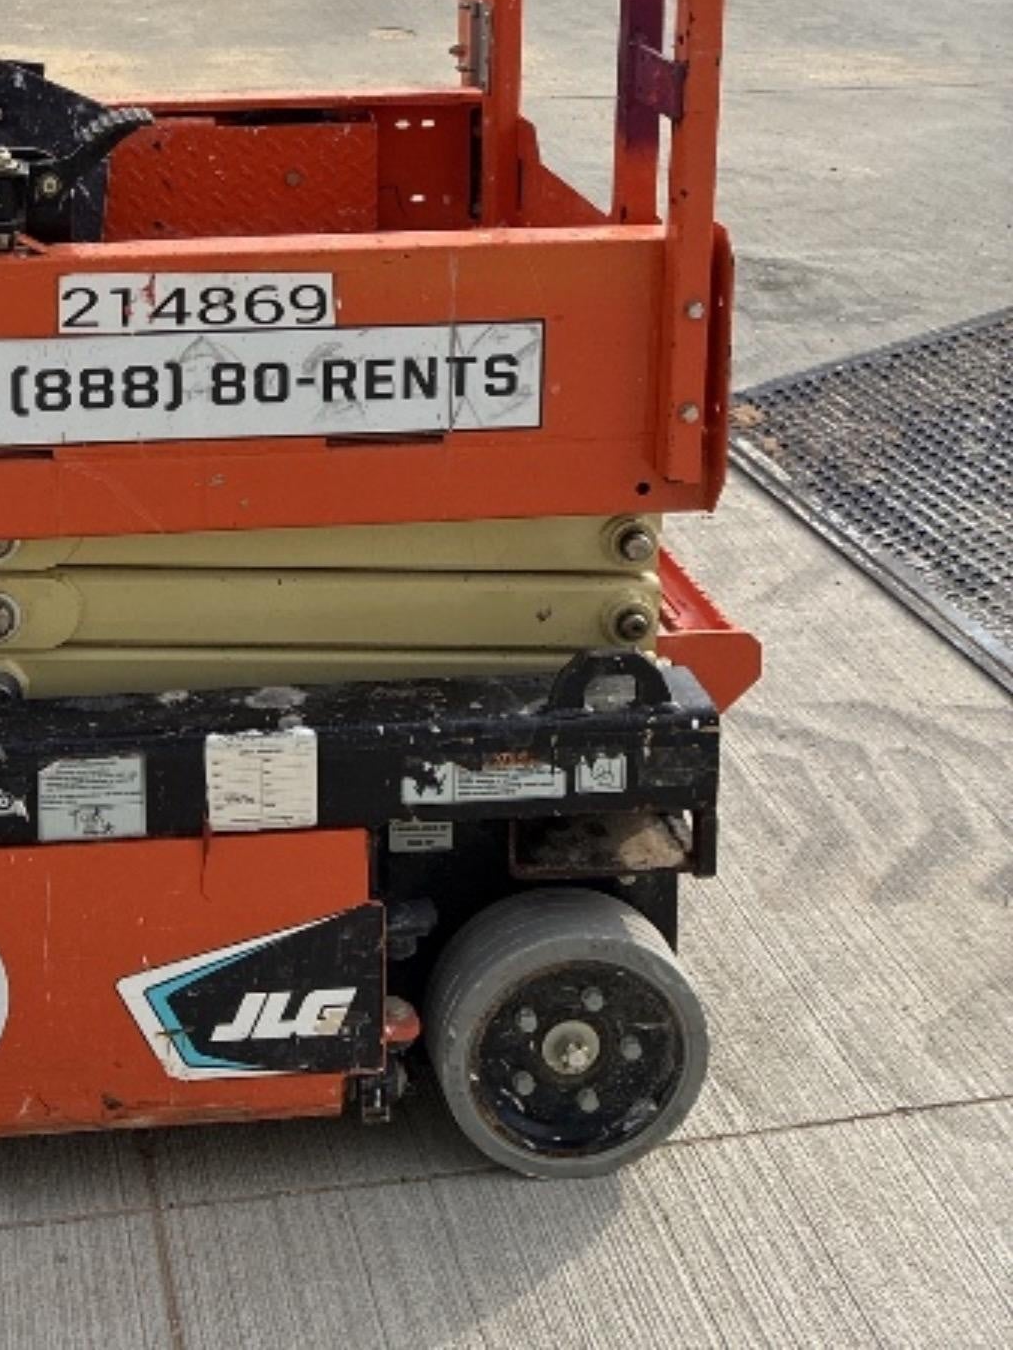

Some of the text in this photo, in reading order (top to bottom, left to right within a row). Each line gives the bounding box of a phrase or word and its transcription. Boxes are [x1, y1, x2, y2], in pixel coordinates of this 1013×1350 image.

[62, 283, 328, 329] 214869
[11, 352, 519, 418] (888) 80-RENTS
[210, 987, 357, 1042] JLG
